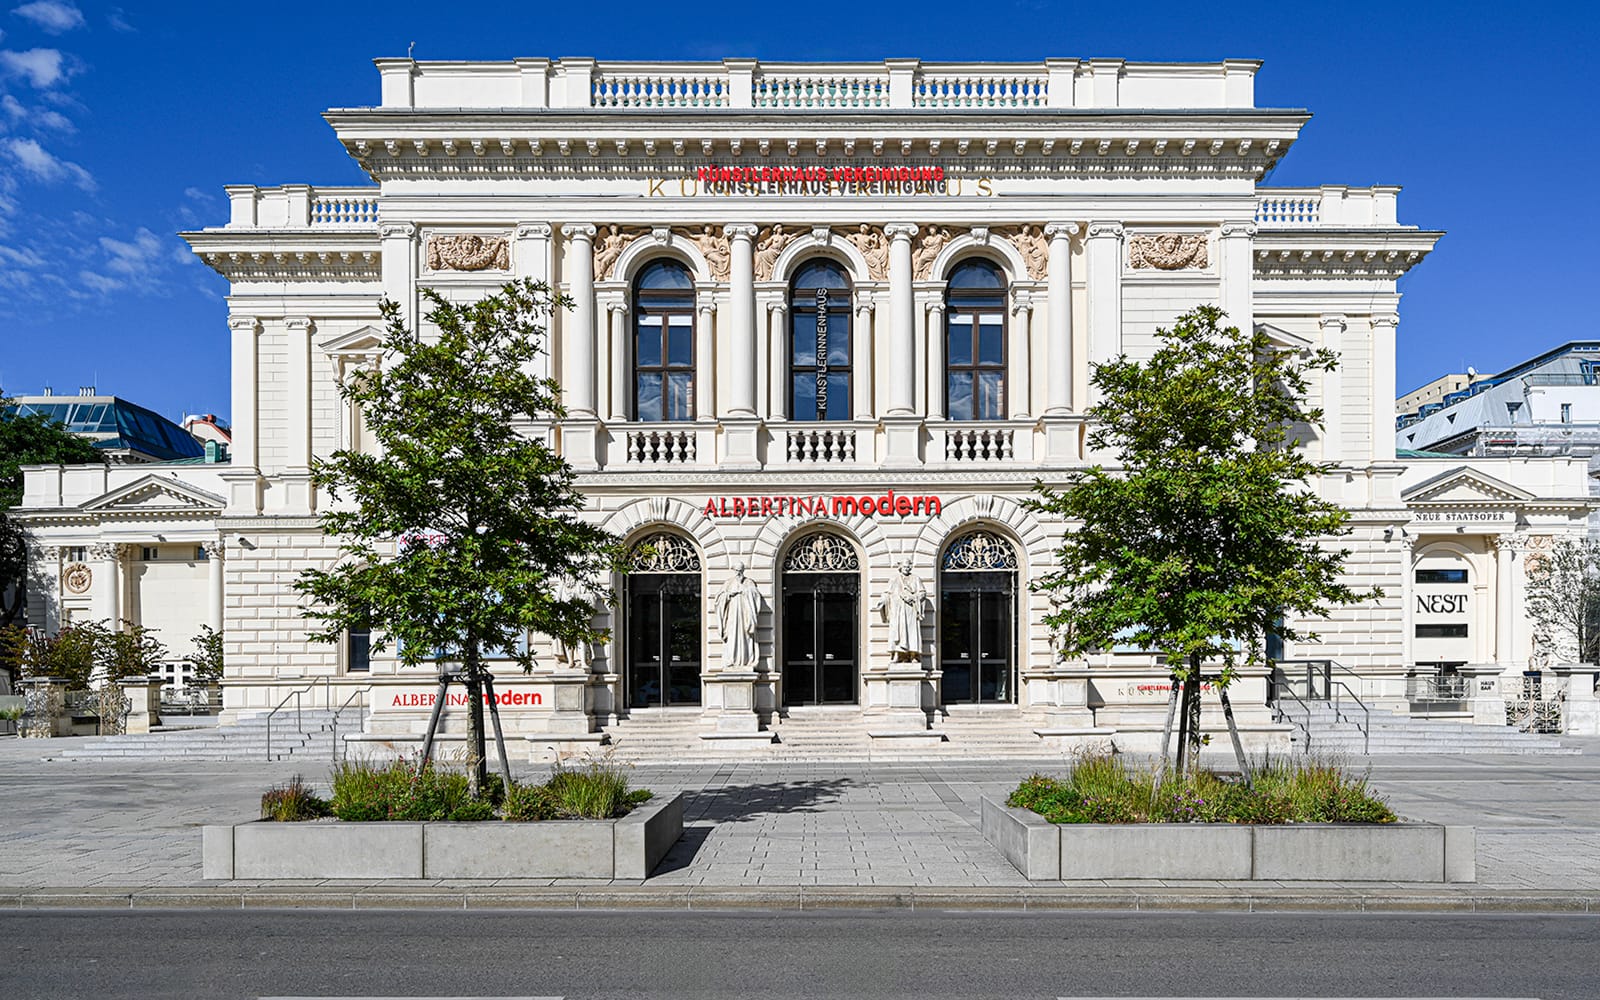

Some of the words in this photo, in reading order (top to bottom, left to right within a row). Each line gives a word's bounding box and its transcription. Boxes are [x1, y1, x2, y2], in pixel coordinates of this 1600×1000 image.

[833, 166, 944, 182] VEREINIGUNG
[703, 496, 829, 517] ALBERTINA
[832, 489, 942, 517] modern
[1415, 513, 1441, 521] NEUE
[1445, 513, 1505, 521] STAATSOPER
[1416, 594, 1468, 613] NEST
[392, 693, 469, 706] ALBERINA
